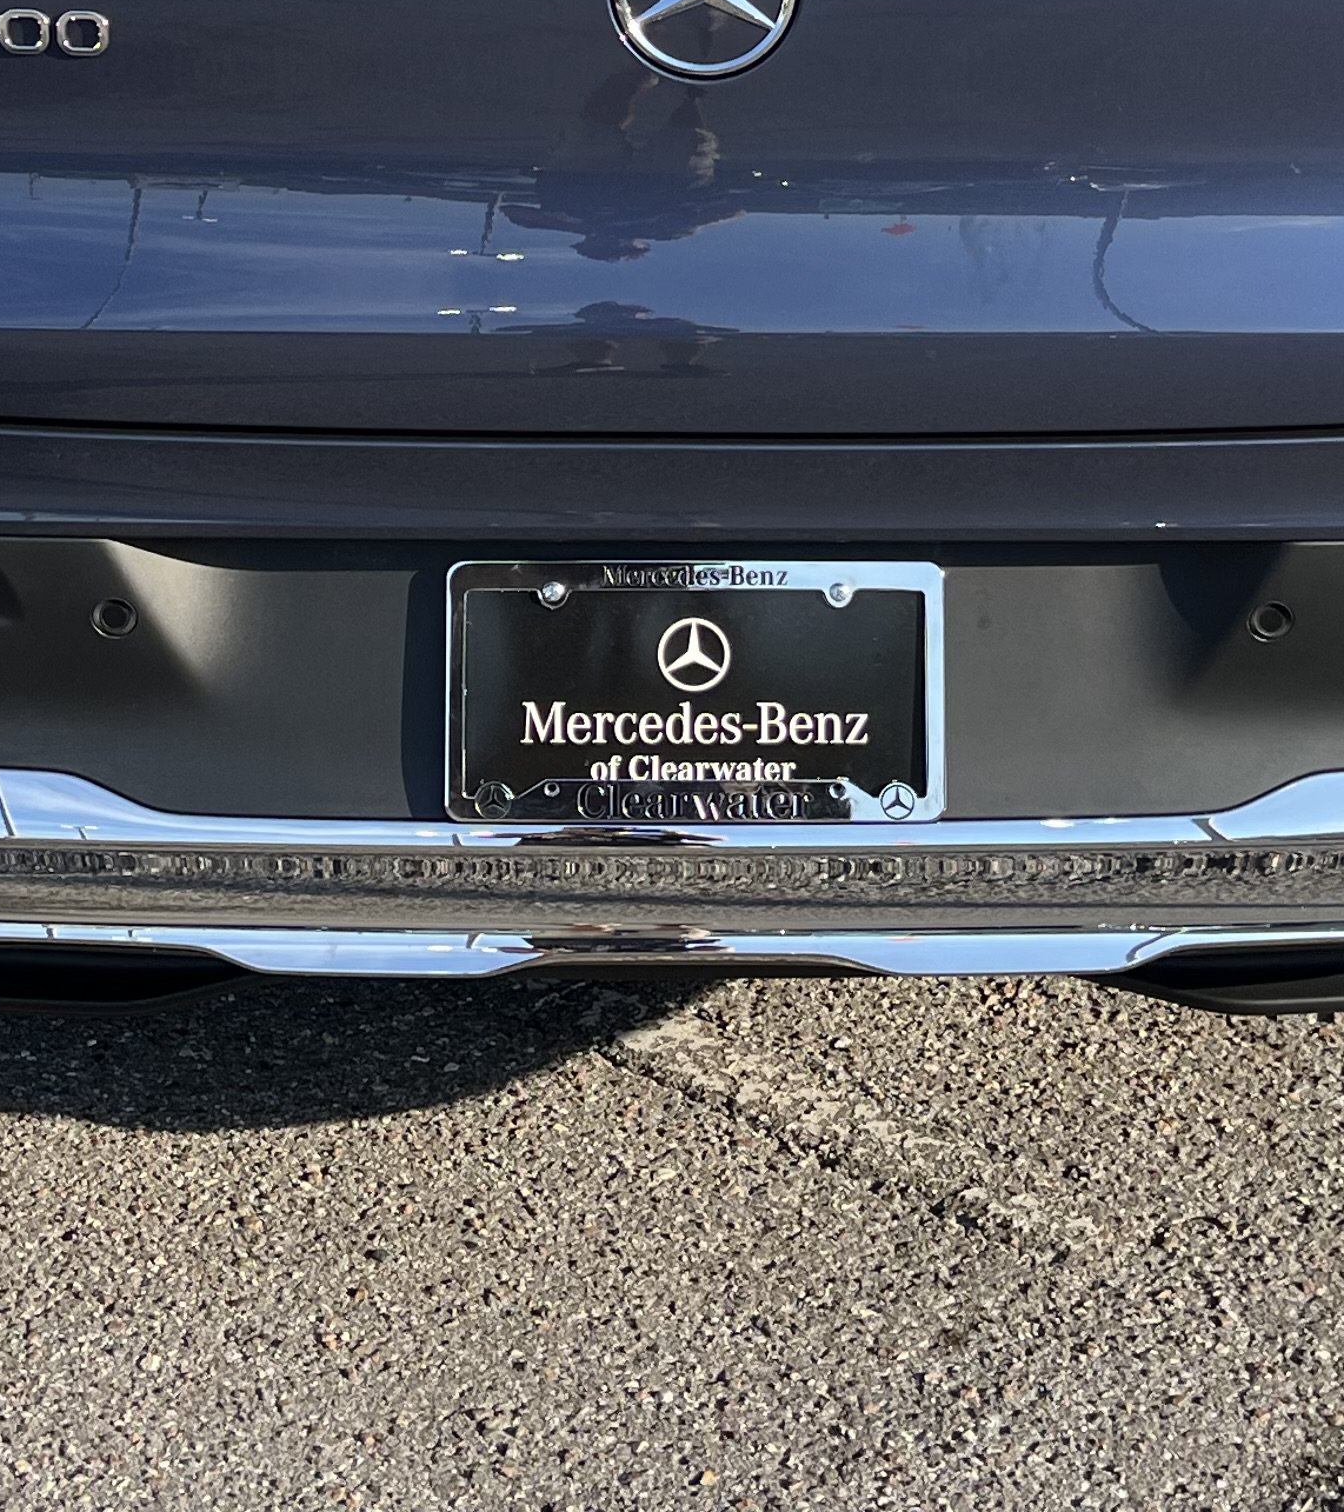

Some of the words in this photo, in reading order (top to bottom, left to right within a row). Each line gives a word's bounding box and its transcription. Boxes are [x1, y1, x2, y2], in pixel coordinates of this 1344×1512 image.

[602, 565, 789, 587] Mercedes-Benz
[519, 701, 869, 746] Mercedes-Benz
[590, 756, 620, 782] of
[627, 756, 797, 781] Clearwater
[577, 782, 811, 820] Clearwater
